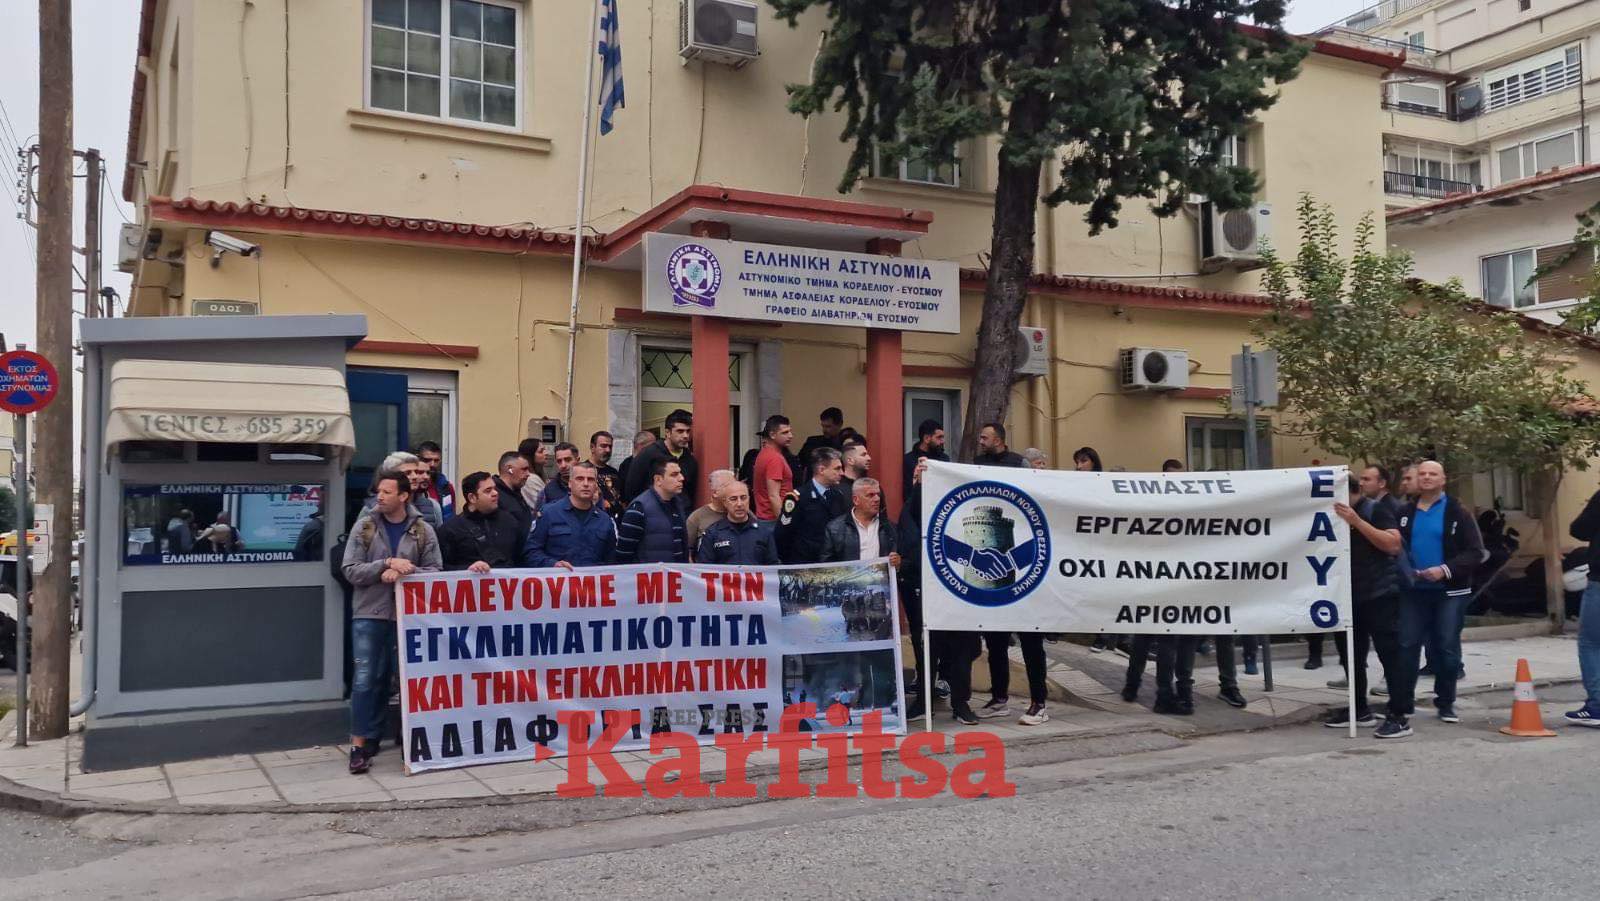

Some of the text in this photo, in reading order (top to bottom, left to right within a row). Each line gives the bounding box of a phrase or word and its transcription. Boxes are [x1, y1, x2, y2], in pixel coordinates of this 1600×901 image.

[744, 249, 932, 281] ΕΛΛΗΝΙΚΗ ΑΣΤΥΝΟΜΙΑ
[738, 271, 801, 286] ΑΣΤΥΝΟΜΙΚΟ
[806, 277, 839, 290] ΤΜΗΜΑ
[843, 280, 895, 294] ΚΟΡΔΕΛΙΟΥ
[901, 285, 944, 298] ΕΥΟΣΜΟΥ
[209, 304, 241, 313] ΟΔΟΣ
[742, 287, 778, 299] ΤΜΗΜΑ
[782, 291, 835, 304] ΑΣΦΑΛΕΙΑΣ
[839, 295, 891, 309] ΚΟΡΔΕΛΙΟΥ
[898, 300, 940, 312] ΕΥΟΣΜΟΥ
[765, 304, 920, 325] ΓΡΑΦΕΙΟ ΔΙΑΒΑΤΗΡΩΝ ΕΥΟΣΜΟΥ
[8, 365, 38, 373] ΕΚΤΟΣ
[247, 416, 282, 435] 685
[292, 417, 328, 436] 359
[160, 484, 222, 494] ΕΛΛΗΝΙΚΗ
[955, 486, 1018, 500] ΥΠΑΛΛΗΛΩΝ
[1112, 478, 1235, 495] ΕΙΜΑΣΤΕ
[1016, 497, 1042, 527] ΝΟΜΟΥ
[932, 498, 957, 566] ΑΣΤΥΝΟΜΙΚΩΝ
[1075, 515, 1271, 536] ΕΡΓΑΖΟΜΕΝΟΙ
[162, 551, 294, 564] ΕΛΛΗΝΙΚΗ ΑΣΤΥΝΟΜΙΑ
[940, 566, 969, 595] ΕΝΩΣΗ
[1058, 559, 1289, 581] ΟΧΙ ΑΝΑΛΩΣΙΜΟΙ
[403, 571, 765, 615] ΠΑΛΕΥΟΥΜΕ ΜΕ ΤΗΝ
[1115, 605, 1232, 625] ΑΡΙΘΜΟΙ
[405, 614, 768, 663] ΕΓΚΛΗΜΑΤΙΚΟΤΗΤΑ
[407, 658, 767, 713] ΚΑΙ ΤΗΝ ΕΓΚΛΗΜΑΤΙΚΗ
[697, 702, 769, 736] ΣΑΣ
